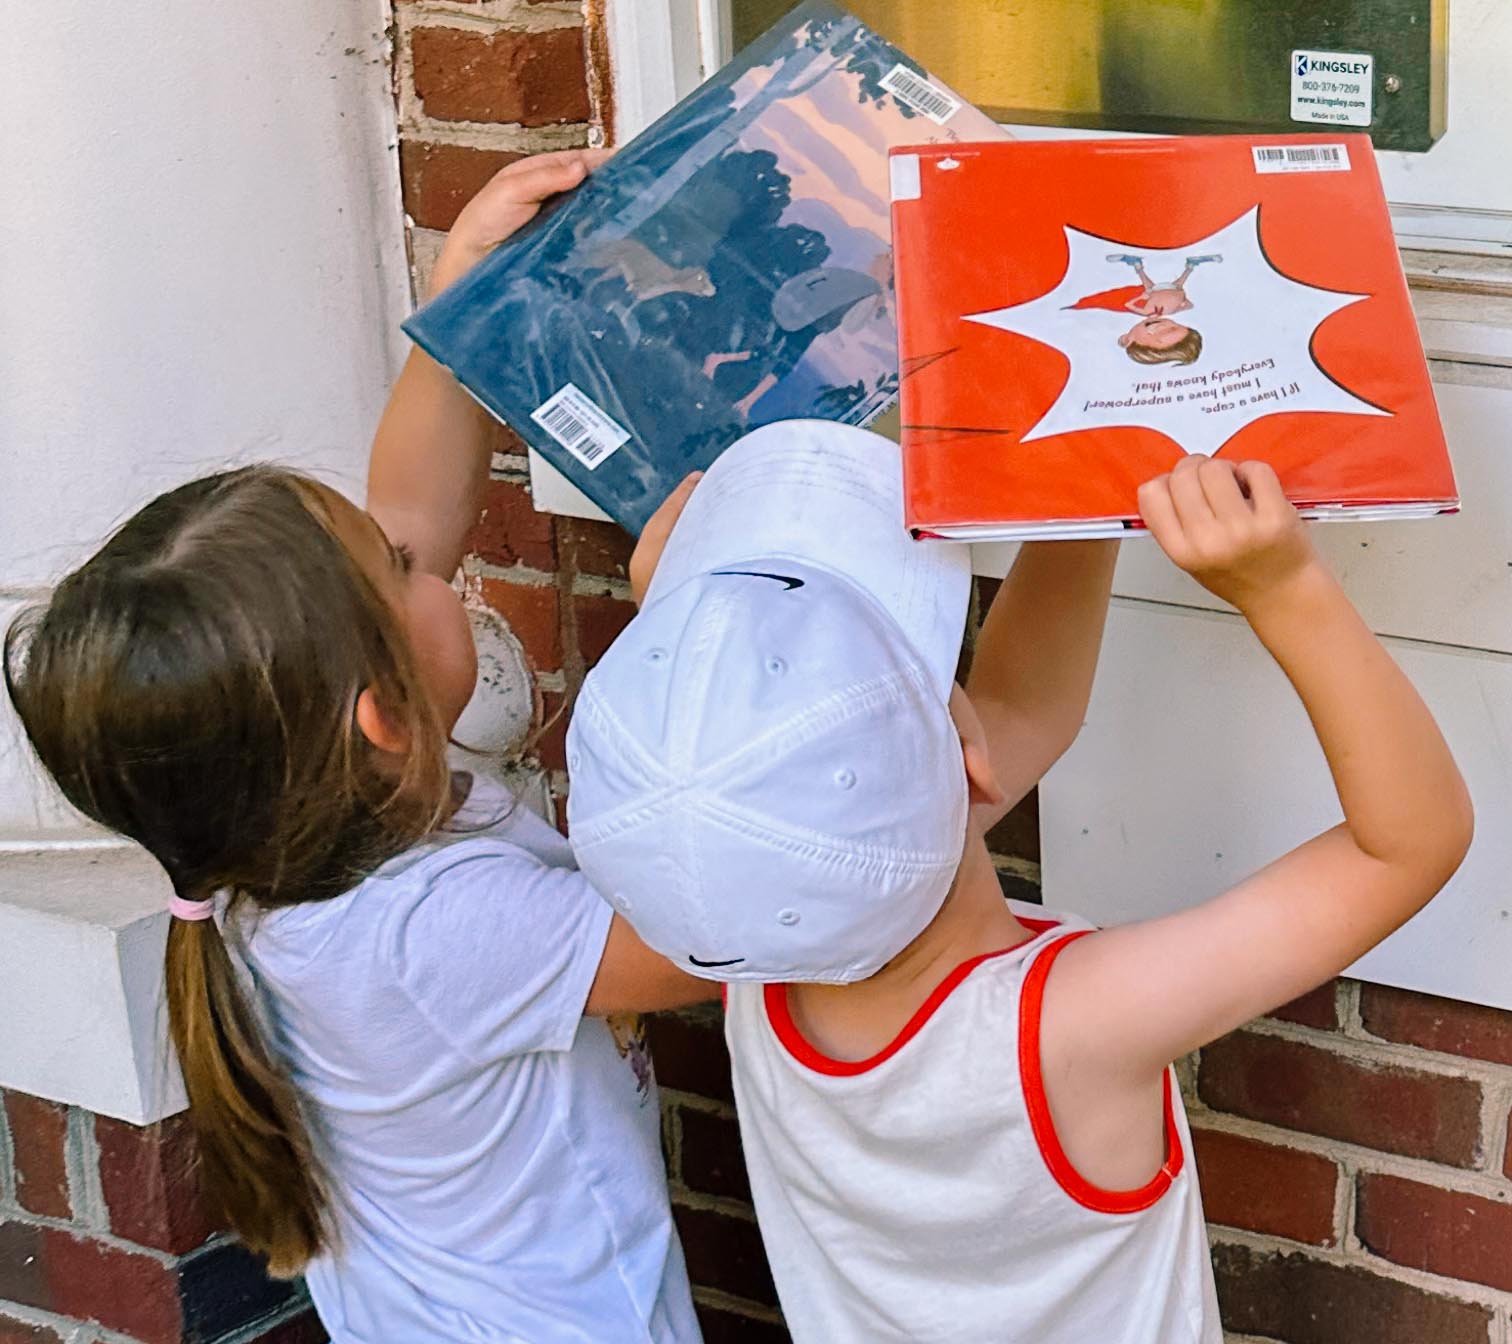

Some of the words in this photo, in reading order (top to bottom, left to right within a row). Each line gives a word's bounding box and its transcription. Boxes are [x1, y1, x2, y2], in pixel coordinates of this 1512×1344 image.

[1311, 61, 1369, 74] KINGSLEY
[1210, 358, 1276, 382] Everybody
[1166, 375, 1207, 388] knows
[1221, 380, 1252, 395] must
[1188, 388, 1218, 400] have
[1250, 389, 1280, 401] have
[1083, 395, 1173, 412] superpower!
